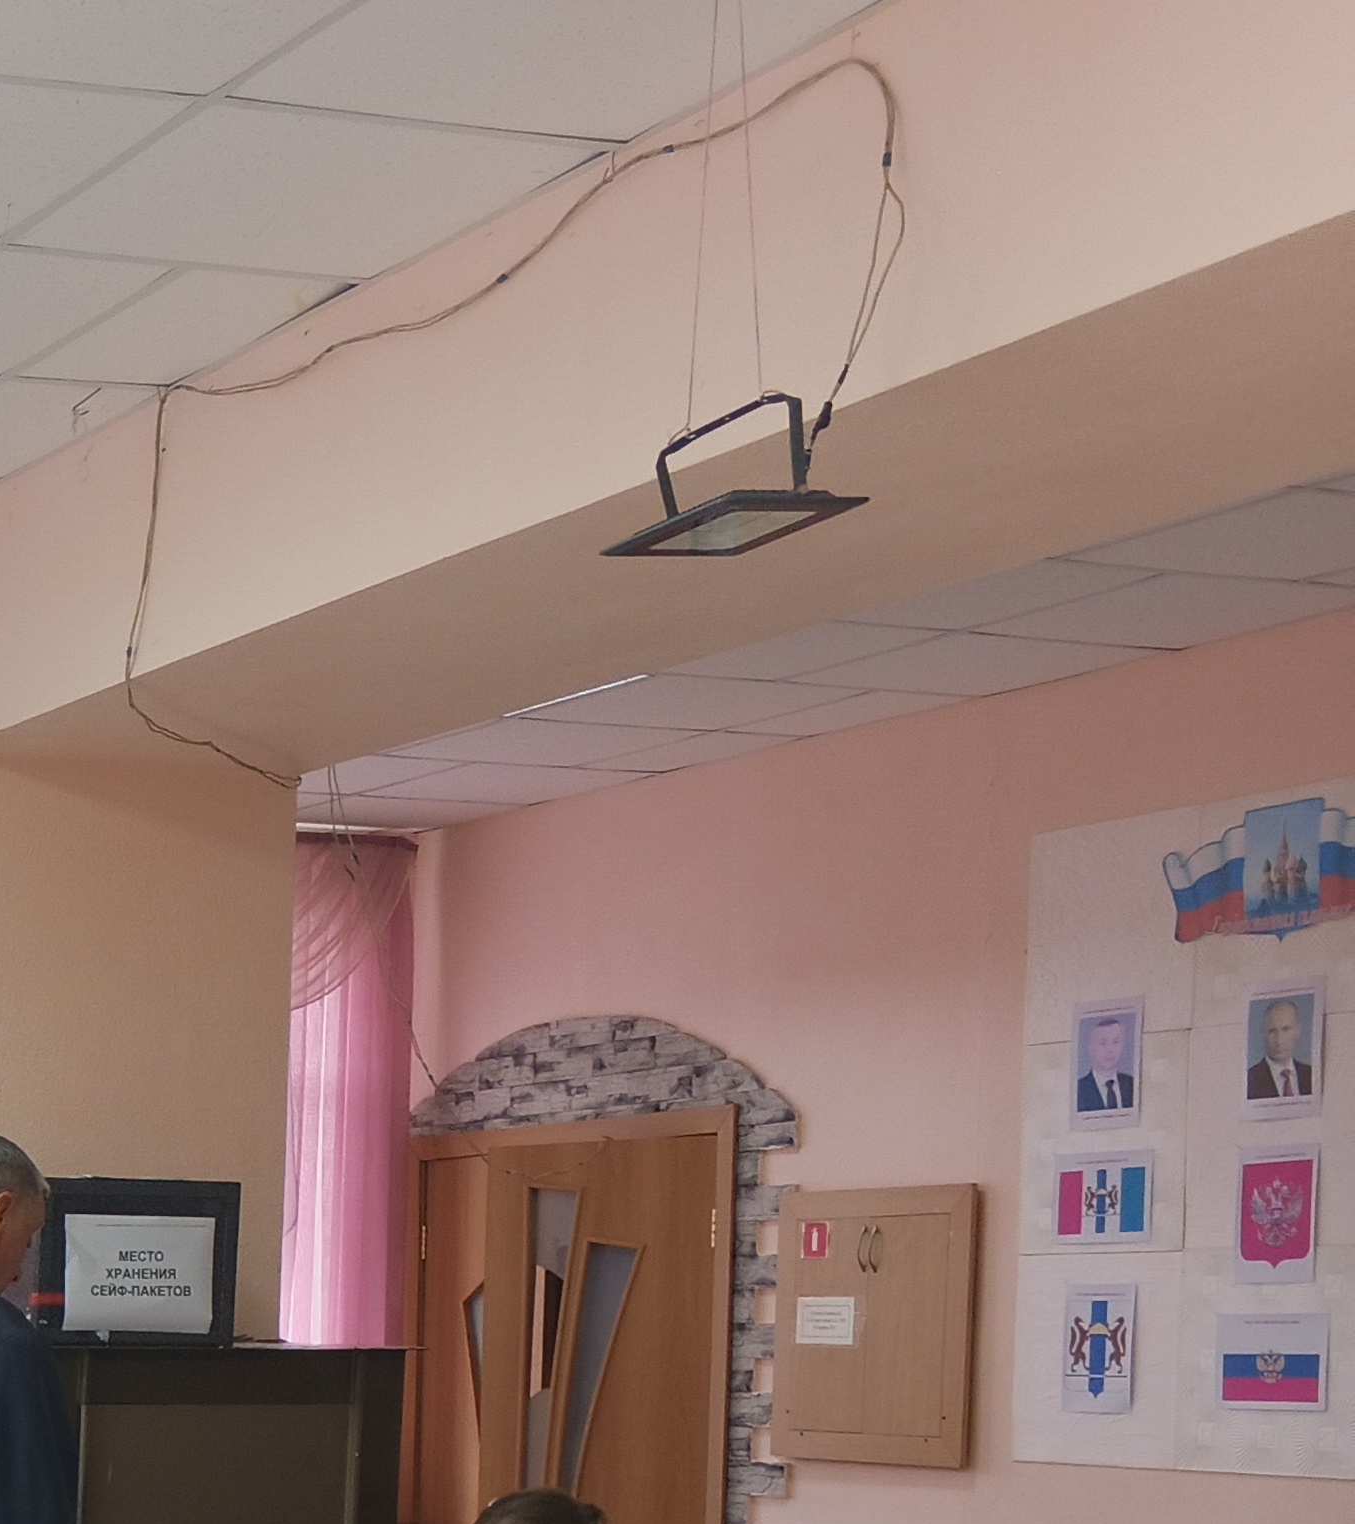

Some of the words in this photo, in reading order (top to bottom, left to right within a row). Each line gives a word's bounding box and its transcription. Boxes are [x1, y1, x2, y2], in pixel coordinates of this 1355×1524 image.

[118, 1250, 164, 1263] МЕСТО
[106, 1267, 177, 1280] ХРАНЕНИЯ
[90, 1283, 191, 1298] СЕЙФ-ПАКЕТОВ
